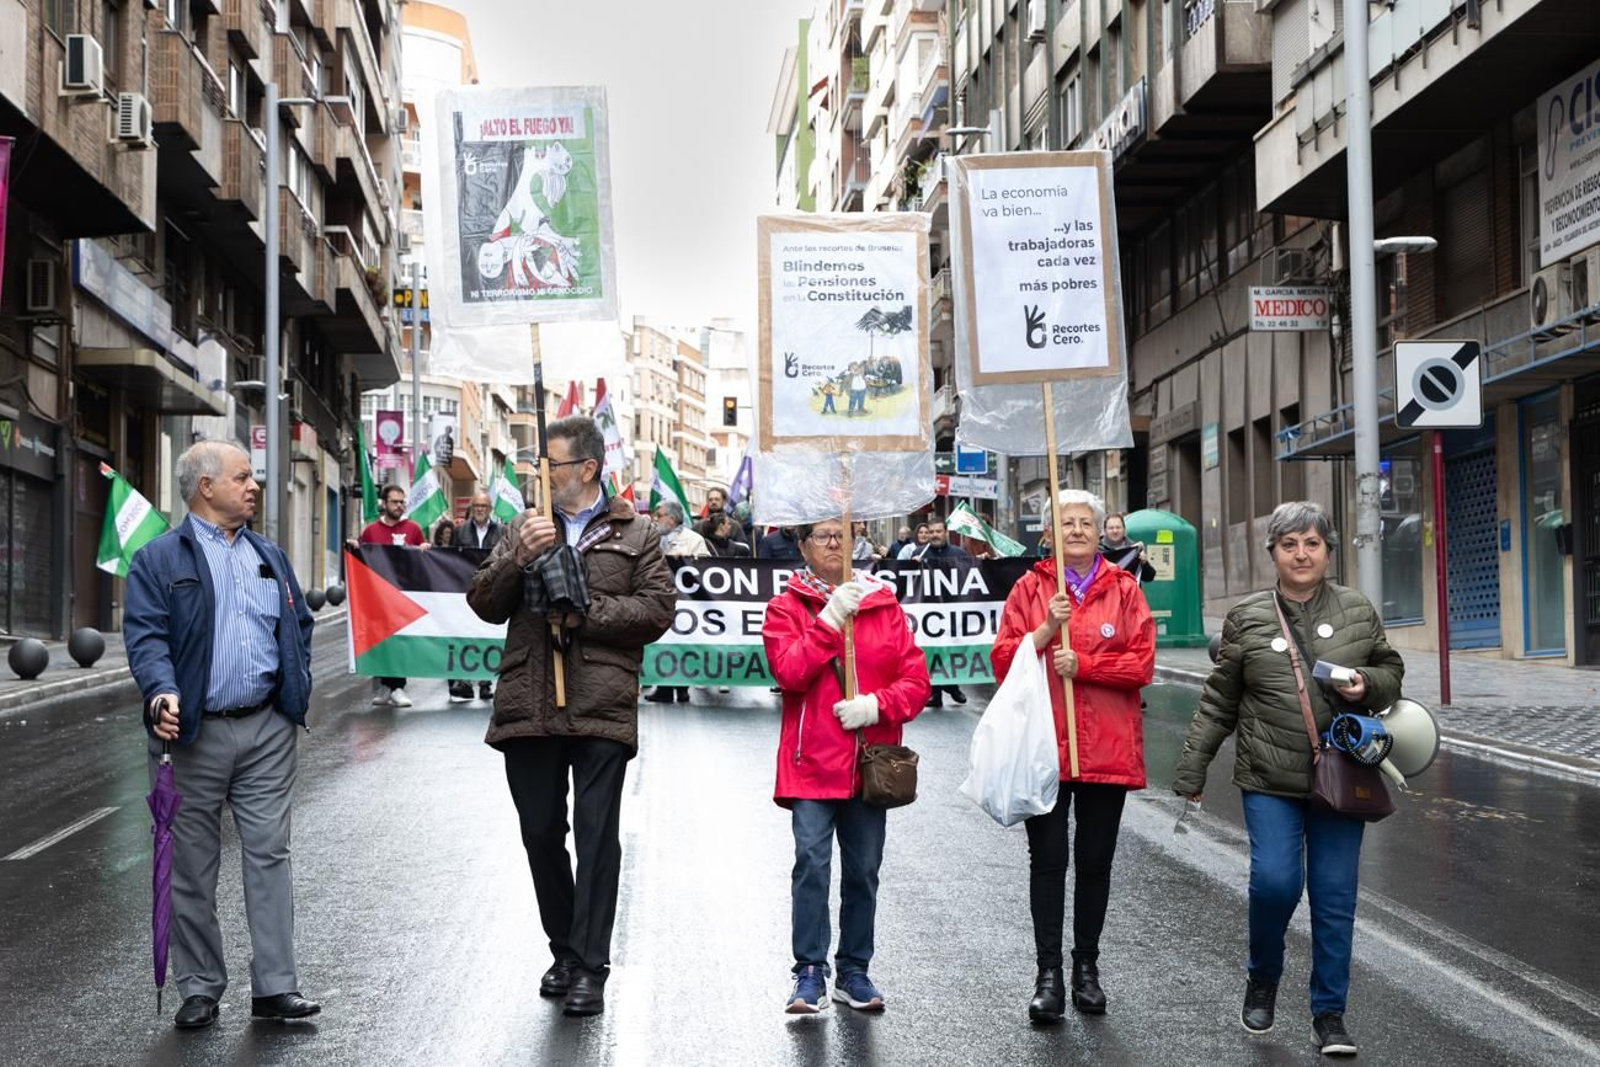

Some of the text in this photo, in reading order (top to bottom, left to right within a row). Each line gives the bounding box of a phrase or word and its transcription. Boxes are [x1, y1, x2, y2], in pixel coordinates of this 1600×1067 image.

[509, 118, 523, 135] EL
[524, 117, 557, 135] FUEGO
[982, 185, 1068, 200] La economía
[983, 204, 1042, 218] va bien...
[1053, 219, 1094, 234] ...y las
[1008, 237, 1095, 252] trabajadoras
[783, 260, 865, 272] Blindemos
[1037, 255, 1097, 267] cada vez
[798, 274, 876, 287] Pensiones
[1019, 278, 1099, 293] más pobres
[807, 289, 904, 302] Constitución
[1254, 299, 1326, 317] MEDICO
[1052, 323, 1101, 334] Recortes
[1053, 334, 1084, 345] Cero.
[675, 566, 990, 597] CON PSTINA
[671, 608, 727, 636] OS
[742, 610, 763, 636] E
[447, 644, 993, 680] ¡CO OCUPA APA
